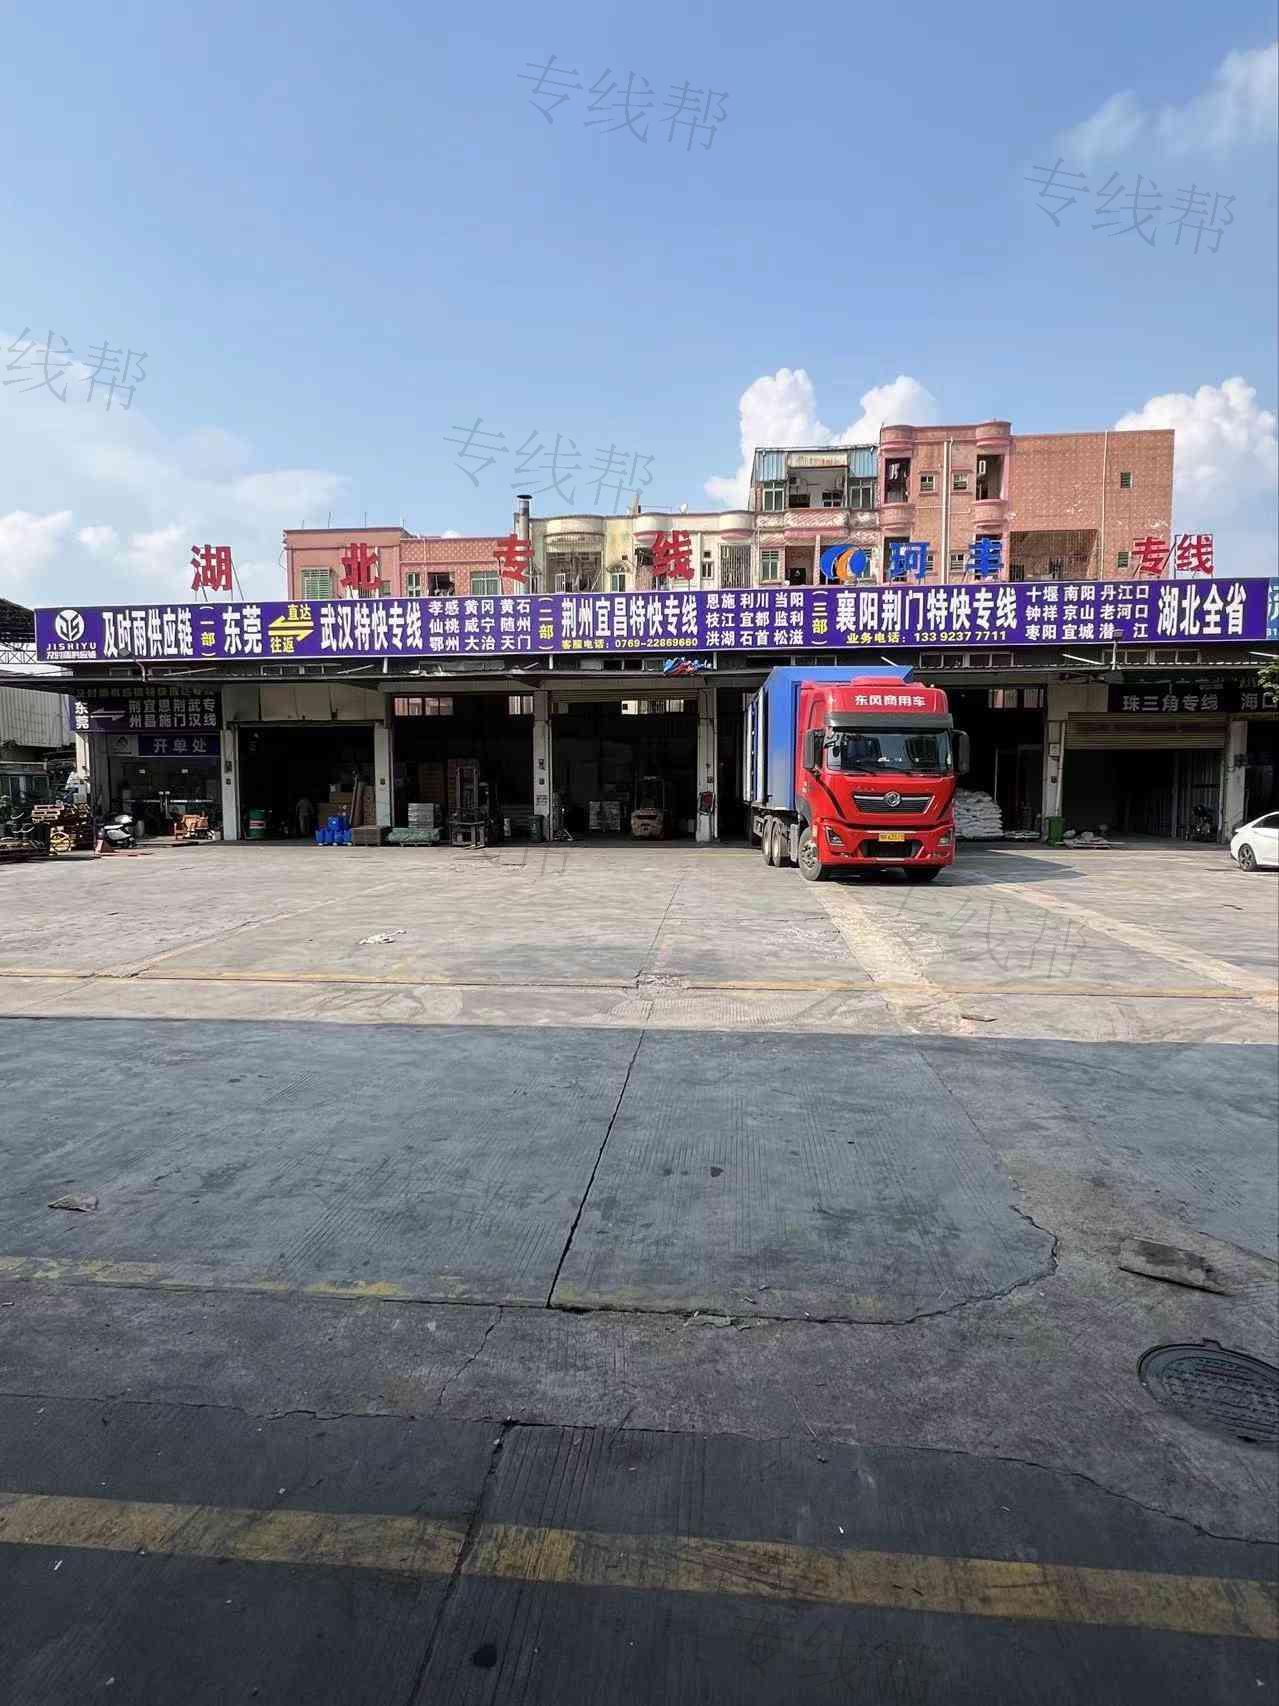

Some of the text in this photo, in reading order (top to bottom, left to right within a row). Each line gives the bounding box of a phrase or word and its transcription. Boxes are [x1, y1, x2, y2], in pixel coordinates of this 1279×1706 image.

[706, 592, 804, 609] 恩施 利川 当阳
[1026, 584, 1150, 603] 十堰 南阳 丹江口
[287, 604, 311, 620] 直达
[428, 599, 531, 616] 孝感 黄冈 黄石
[561, 594, 698, 638] 荆州宜昌特快专线
[835, 583, 1018, 633] 襄阳荆门特快专线
[1025, 603, 1149, 621] 钟祥 京山 老河口
[1157, 583, 1247, 636] 湖北全省
[320, 601, 423, 652] 武汉特快专线
[429, 616, 531, 634] 仙桃 咸宁 随州
[706, 611, 804, 628] 枝江 宜都 监利
[102, 607, 194, 658] 及时雨供应链
[222, 603, 262, 655] 东莞
[914, 632, 937, 642] 133
[940, 631, 971, 641] 9237
[975, 630, 1006, 640] 7711
[1025, 624, 1057, 640] 枣阳
[1062, 623, 1094, 640] 宜城
[46, 642, 97, 651] JISHIYU
[271, 637, 295, 653] 往返
[429, 636, 459, 652] 鄂州
[500, 635, 531, 650] 天门
[706, 629, 804, 647] 洪湖 石首 松滋
[855, 694, 927, 707] 东风商用车
[1121, 693, 1218, 712] 珠三角专线
[152, 736, 209, 753] 开单处
